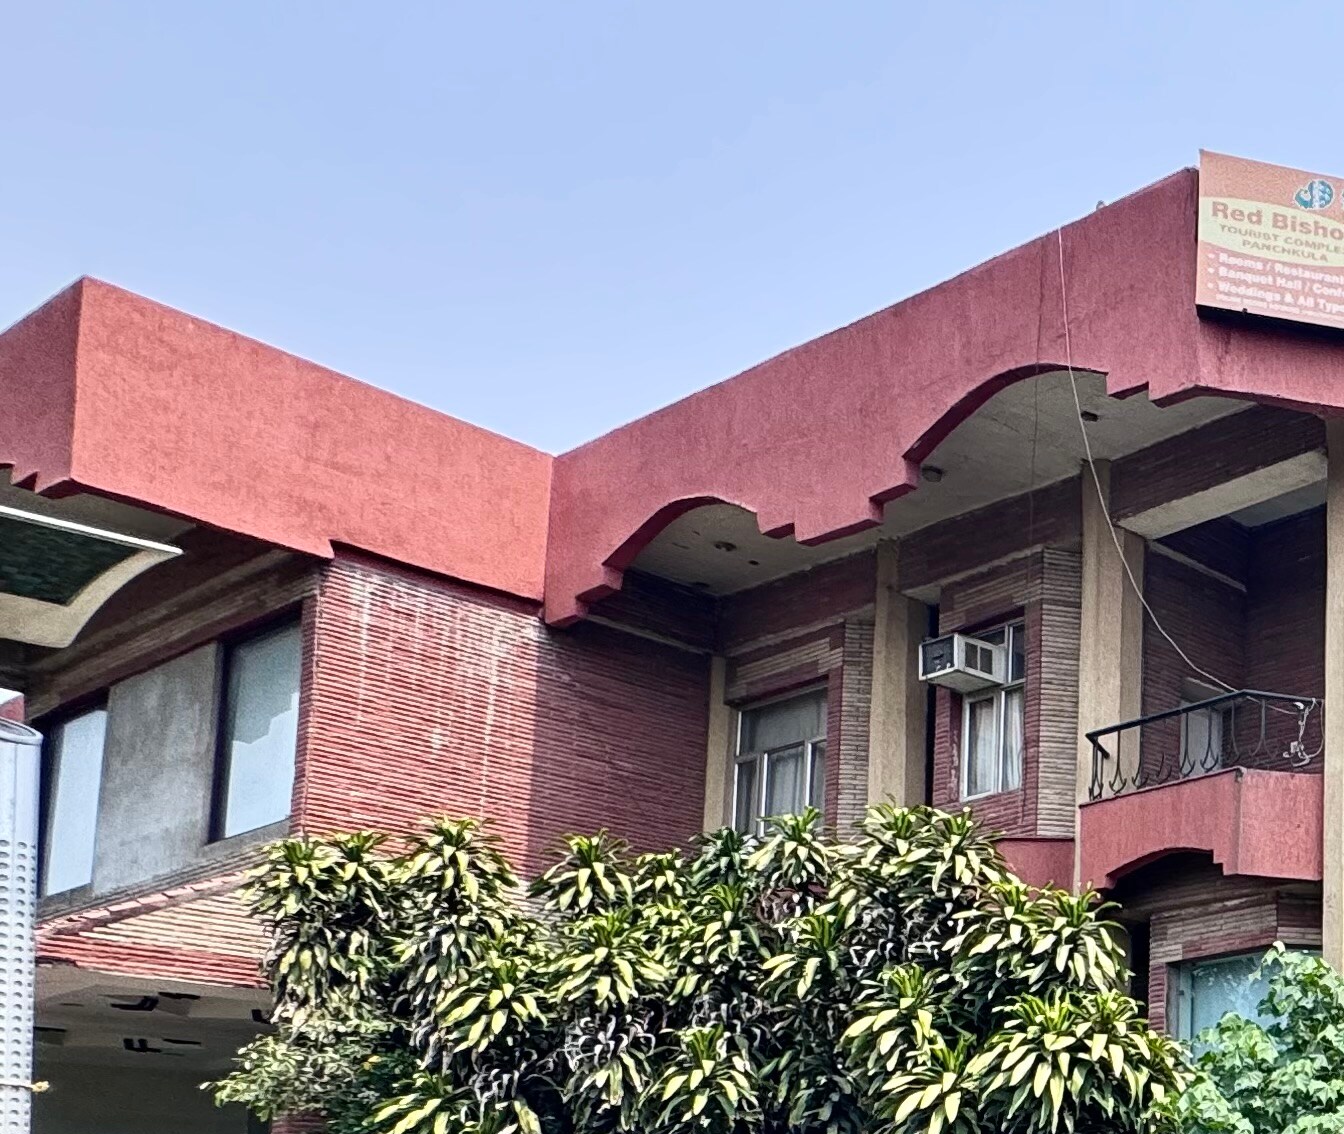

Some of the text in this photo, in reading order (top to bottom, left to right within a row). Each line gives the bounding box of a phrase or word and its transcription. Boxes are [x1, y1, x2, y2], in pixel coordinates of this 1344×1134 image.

[1211, 201, 1262, 225] Red
[1219, 224, 1280, 242] TOURIST
[1242, 239, 1329, 262] PANCHKULA
[1218, 267, 1273, 286] Banquet
[1276, 276, 1302, 290] Hall
[1219, 253, 1263, 270] Rooms
[1275, 263, 1344, 285] Restaurant
[1217, 281, 1281, 301] Weddings
[1284, 293, 1294, 304] &
[1298, 296, 1315, 308] All
